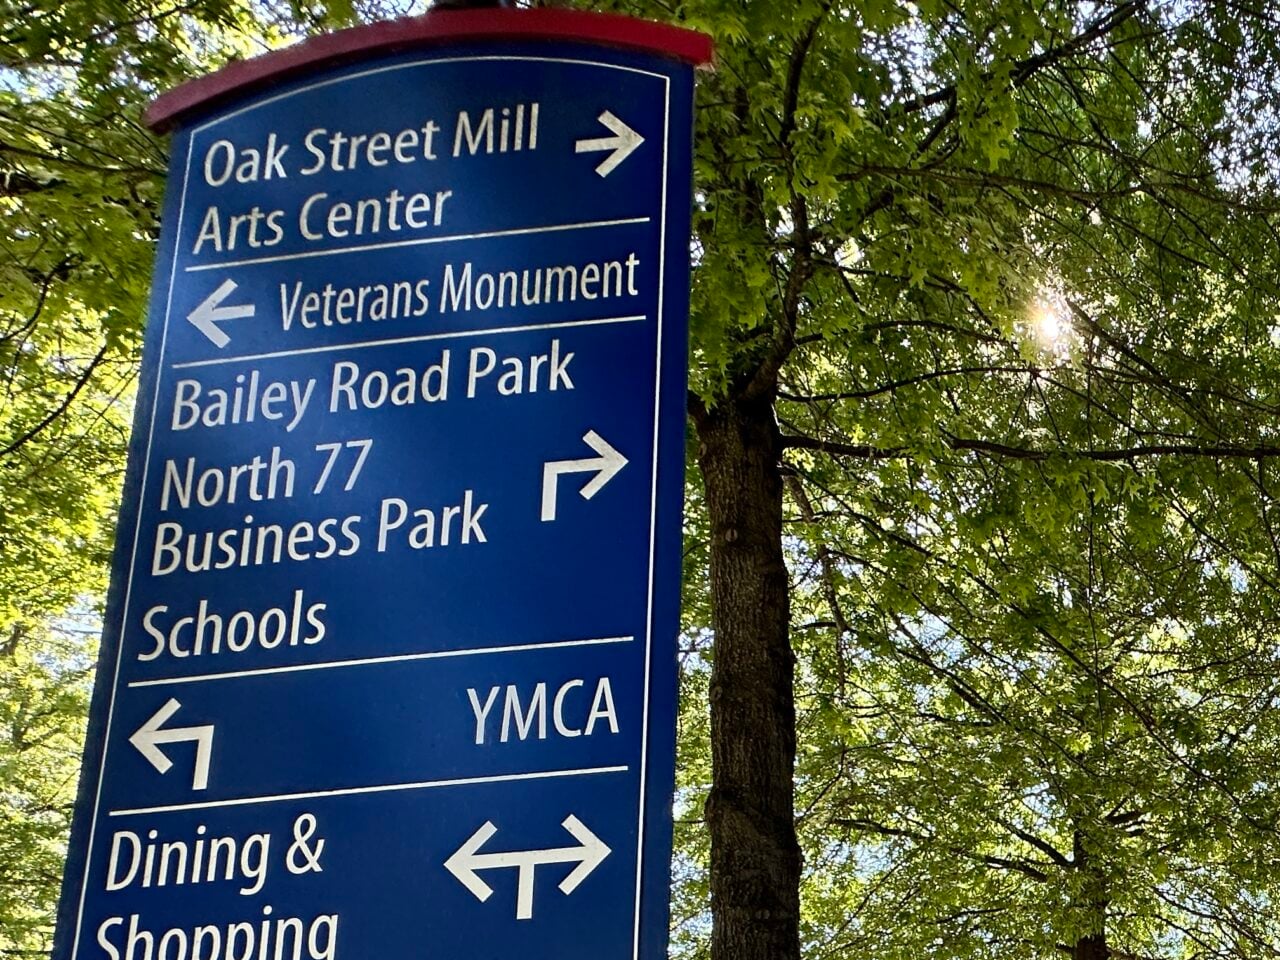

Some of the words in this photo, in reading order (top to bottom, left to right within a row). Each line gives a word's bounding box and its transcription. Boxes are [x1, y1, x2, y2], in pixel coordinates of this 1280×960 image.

[204, 133, 289, 187] Oak
[300, 120, 440, 176] Street
[452, 103, 540, 157] Mill
[192, 206, 284, 255] Arts
[299, 189, 453, 242] Center
[280, 279, 430, 331] Veterans
[439, 252, 640, 313] Monument
[171, 369, 317, 433] Bailey
[329, 349, 451, 413] Road
[466, 339, 575, 399] Park
[160, 445, 296, 511] North
[313, 438, 373, 495] 77
[151, 514, 362, 576] Business
[377, 489, 489, 553] Park
[137, 589, 327, 661] Schools
[466, 677, 620, 745] YMCA
[105, 825, 271, 896] Dining
[285, 813, 325, 875] &
